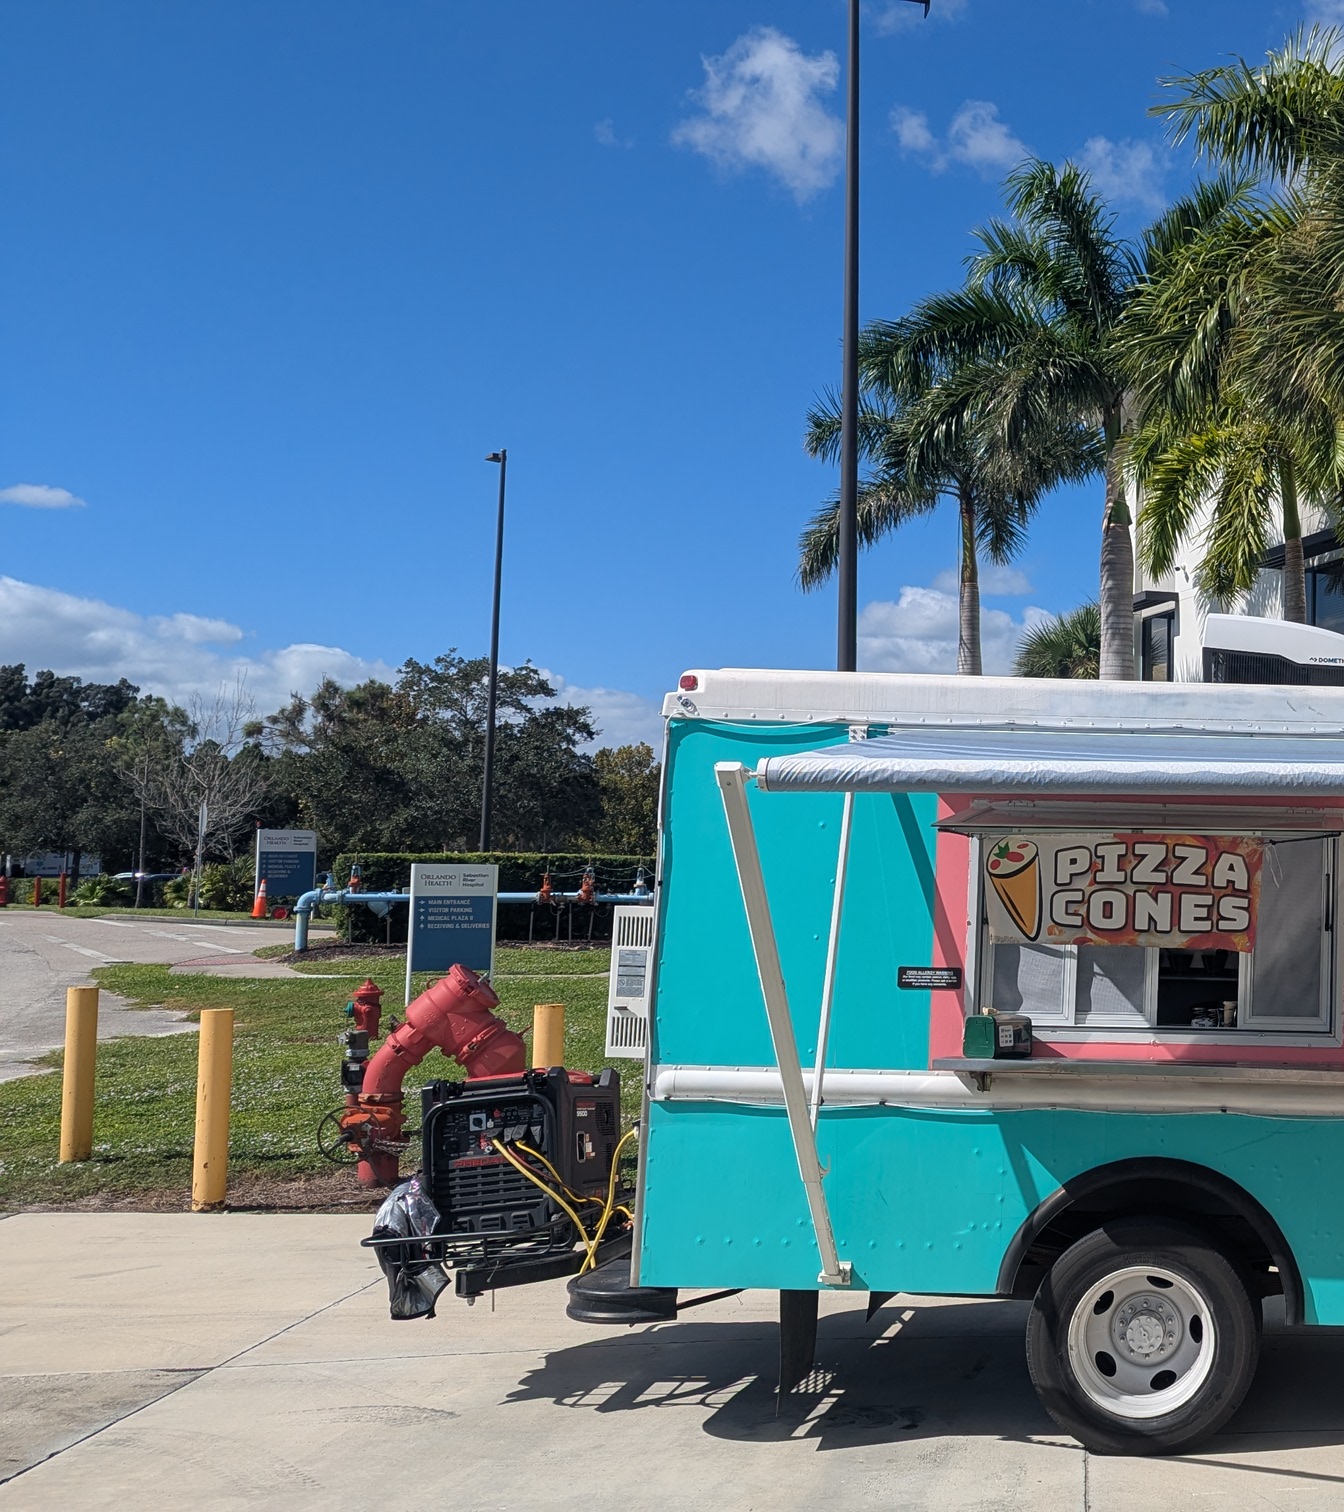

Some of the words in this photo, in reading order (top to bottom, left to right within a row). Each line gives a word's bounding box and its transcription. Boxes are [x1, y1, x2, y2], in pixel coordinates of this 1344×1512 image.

[1054, 842, 1250, 892] PIZZA
[1050, 888, 1250, 934] CONES
[454, 1156, 524, 1168] PREDAT
